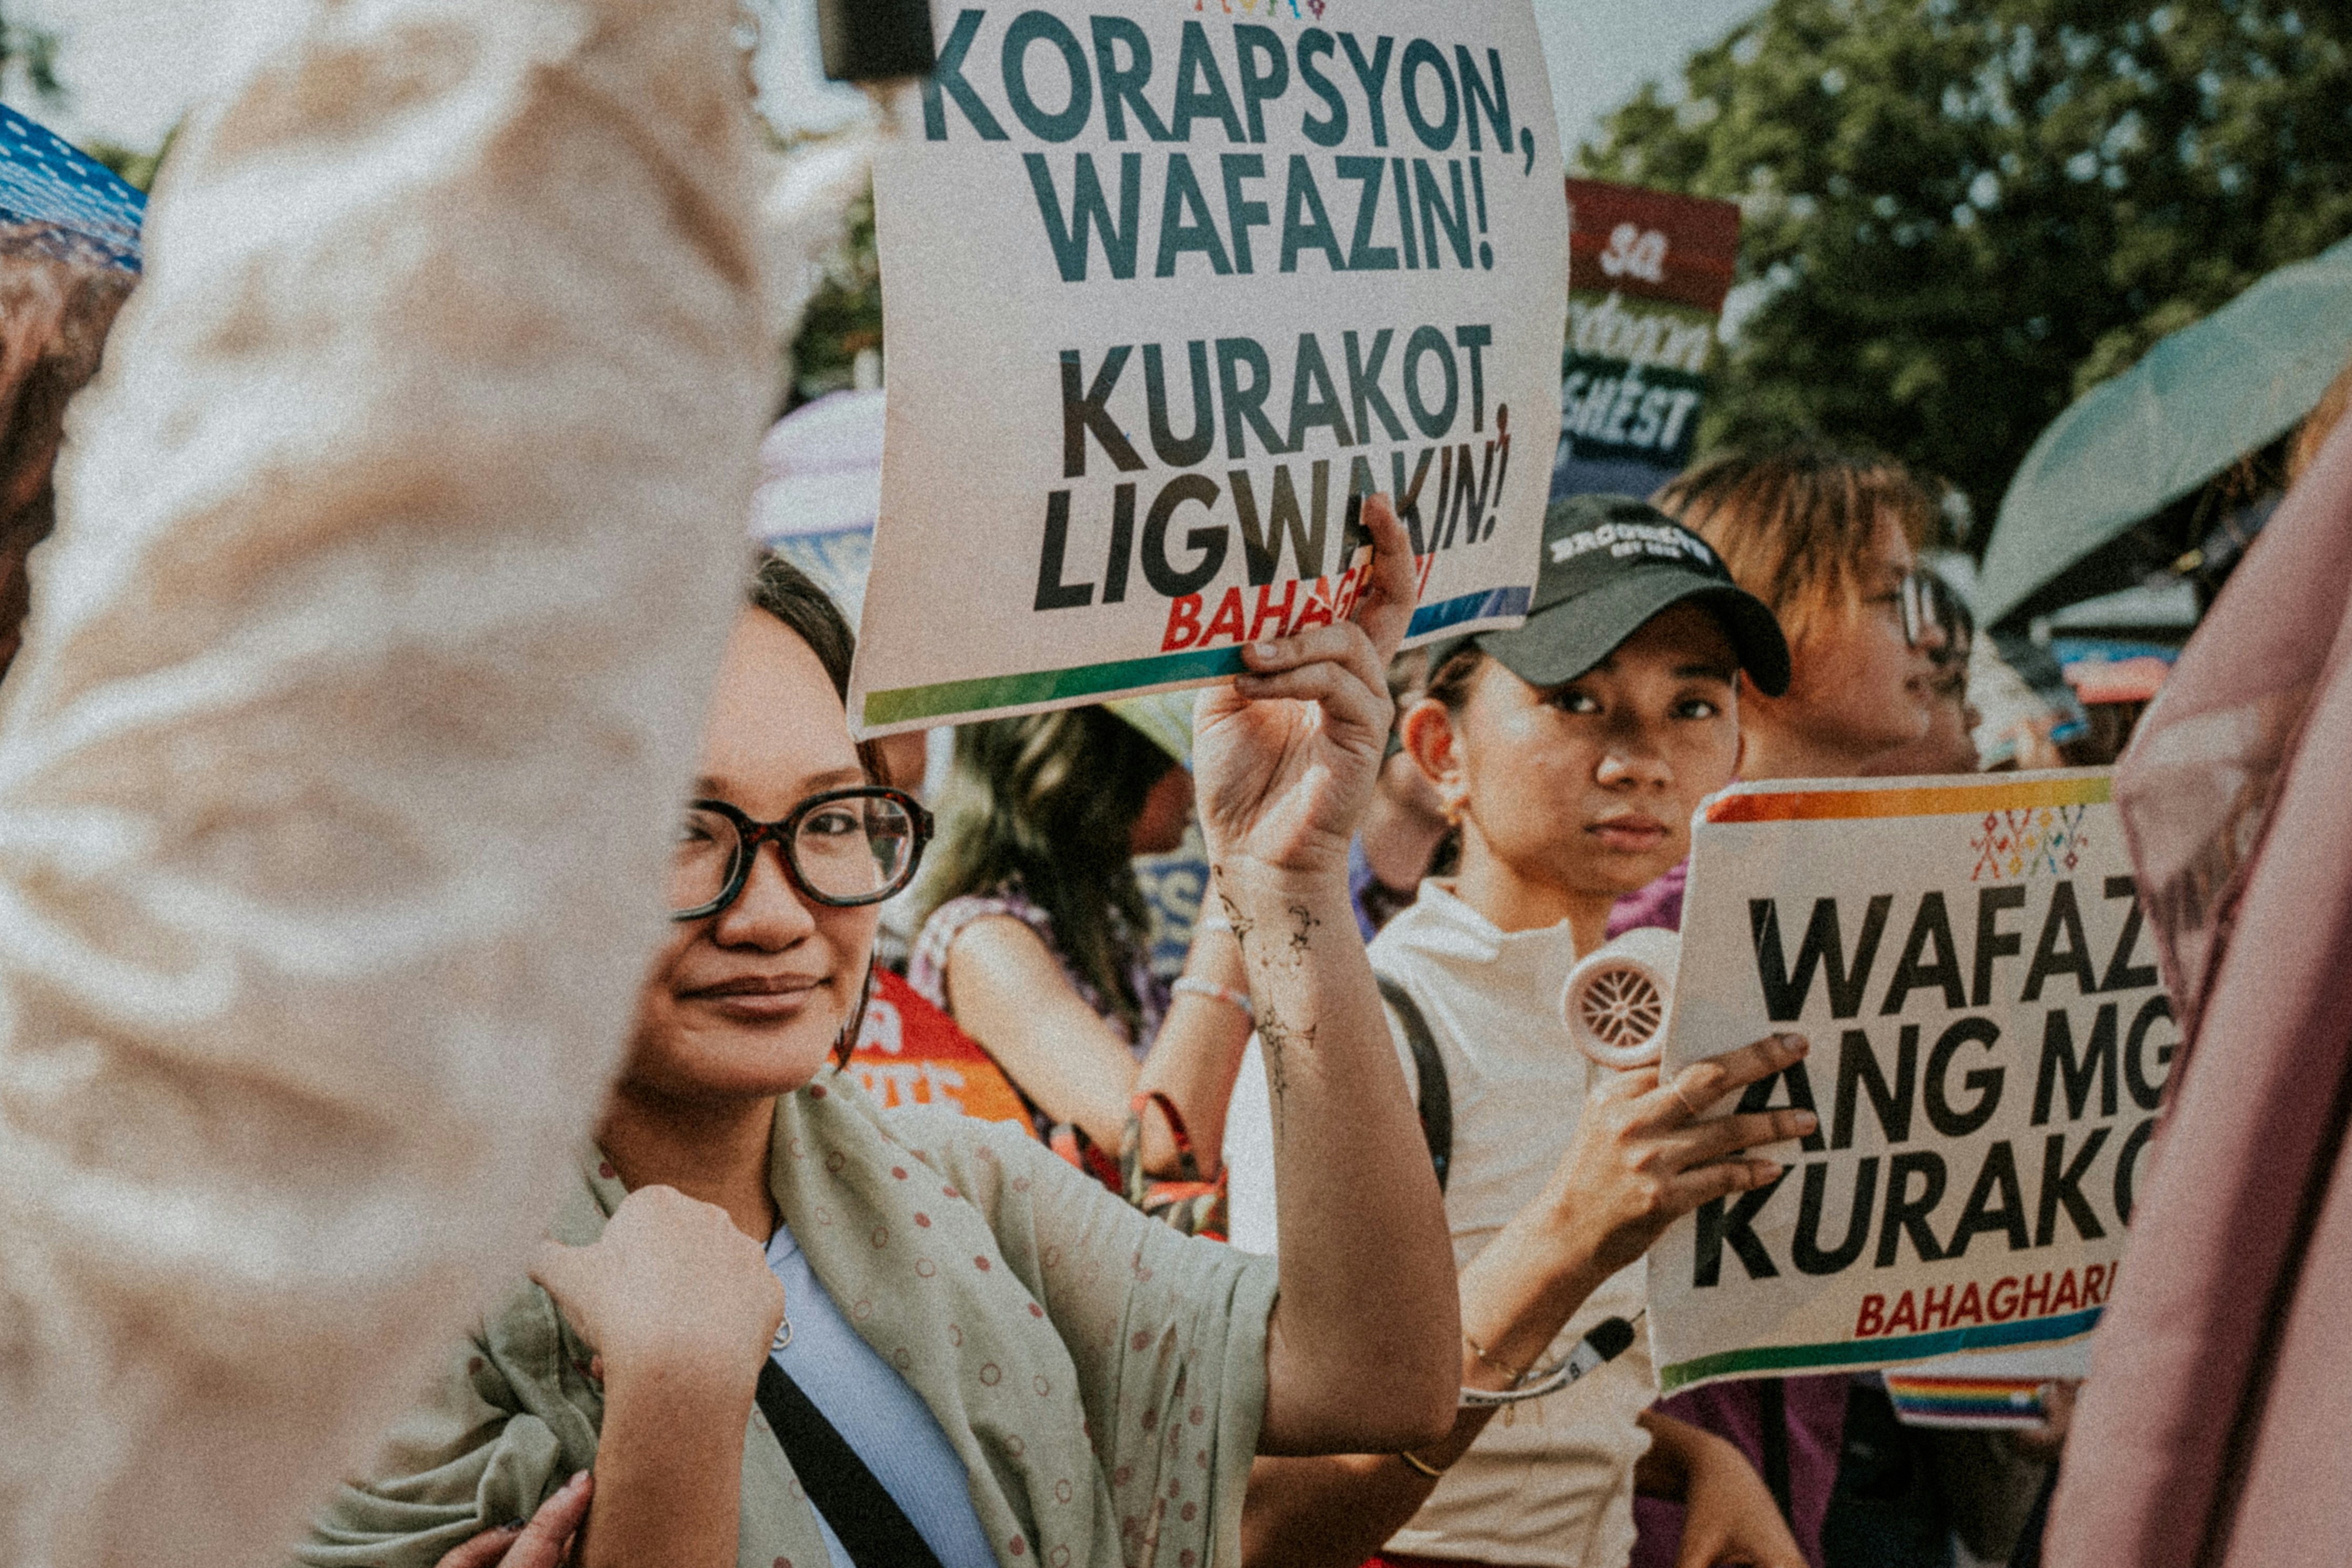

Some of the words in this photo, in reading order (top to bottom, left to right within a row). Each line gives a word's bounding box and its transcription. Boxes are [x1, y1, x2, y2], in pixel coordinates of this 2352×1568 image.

[920, 8, 1535, 177] KORAPSYON,
[1021, 152, 1494, 283] WAFAZIN!
[1059, 324, 1510, 479] KURAKOT,
[1161, 552, 1435, 653] BAHAGI
[1748, 875, 2158, 1022] WAFAZ
[1730, 1017, 2005, 1155] ANG
[1853, 1260, 2119, 1339] BAHAGHARI
